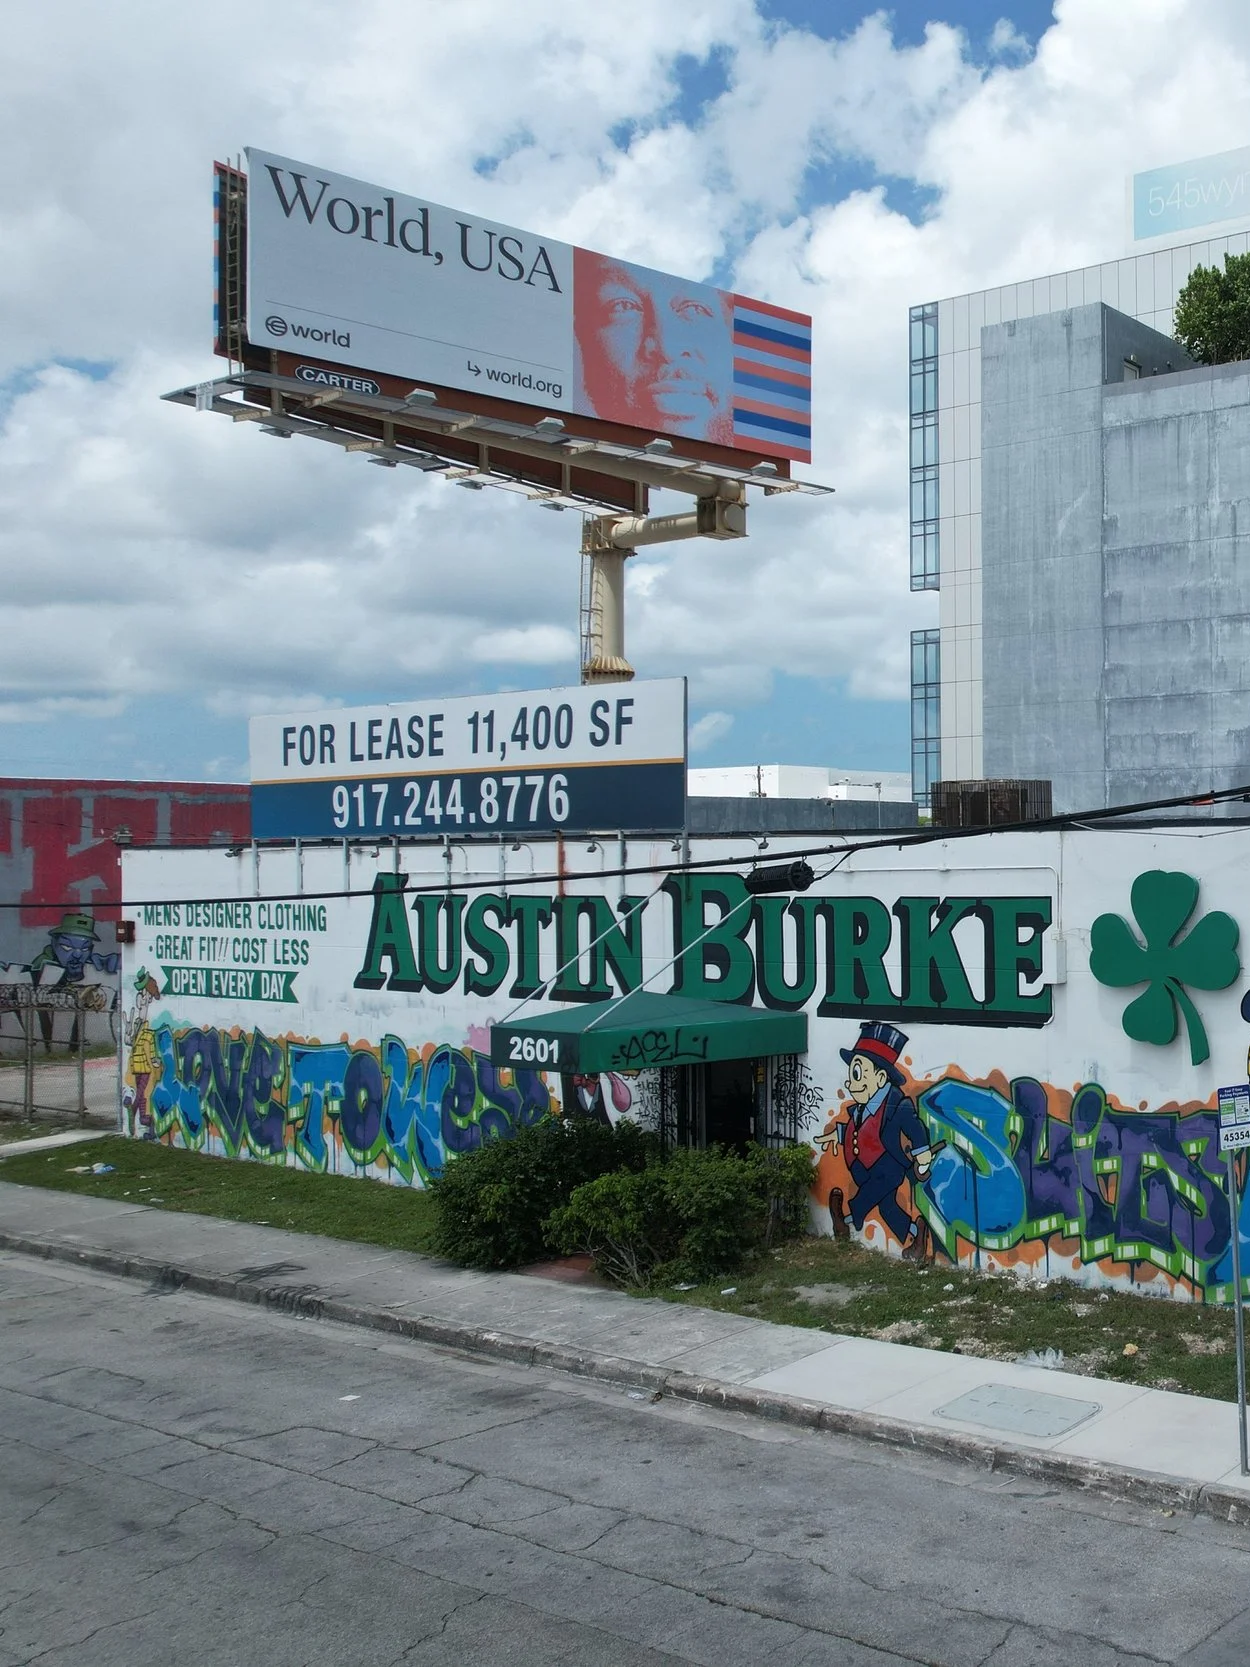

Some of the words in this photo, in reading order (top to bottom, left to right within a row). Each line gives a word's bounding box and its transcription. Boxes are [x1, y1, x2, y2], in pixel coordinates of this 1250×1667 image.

[264, 165, 445, 265] World,
[456, 221, 563, 294] USA
[291, 321, 351, 349] world
[302, 366, 376, 394] CARTER
[486, 365, 563, 398] world.org
[283, 724, 336, 766] FOR
[350, 714, 444, 761] LEASE
[468, 704, 573, 761] 11,400
[589, 698, 634, 747] SF
[332, 773, 569, 828] 917.244.8776
[144, 904, 180, 926] MENS
[186, 903, 251, 930] DESIGNER
[258, 904, 327, 931] CLOTHING
[156, 935, 194, 960] GREAT
[232, 938, 268, 964] COST
[274, 940, 309, 965] LESS
[353, 872, 650, 1001] AUSTIN
[666, 871, 1053, 1028] BURKE
[172, 969, 206, 995] OPEN
[211, 971, 255, 998] EVERY
[261, 973, 286, 1000] DAY
[509, 1035, 559, 1063] 2601
[1224, 1131, 1250, 1142] 45354
